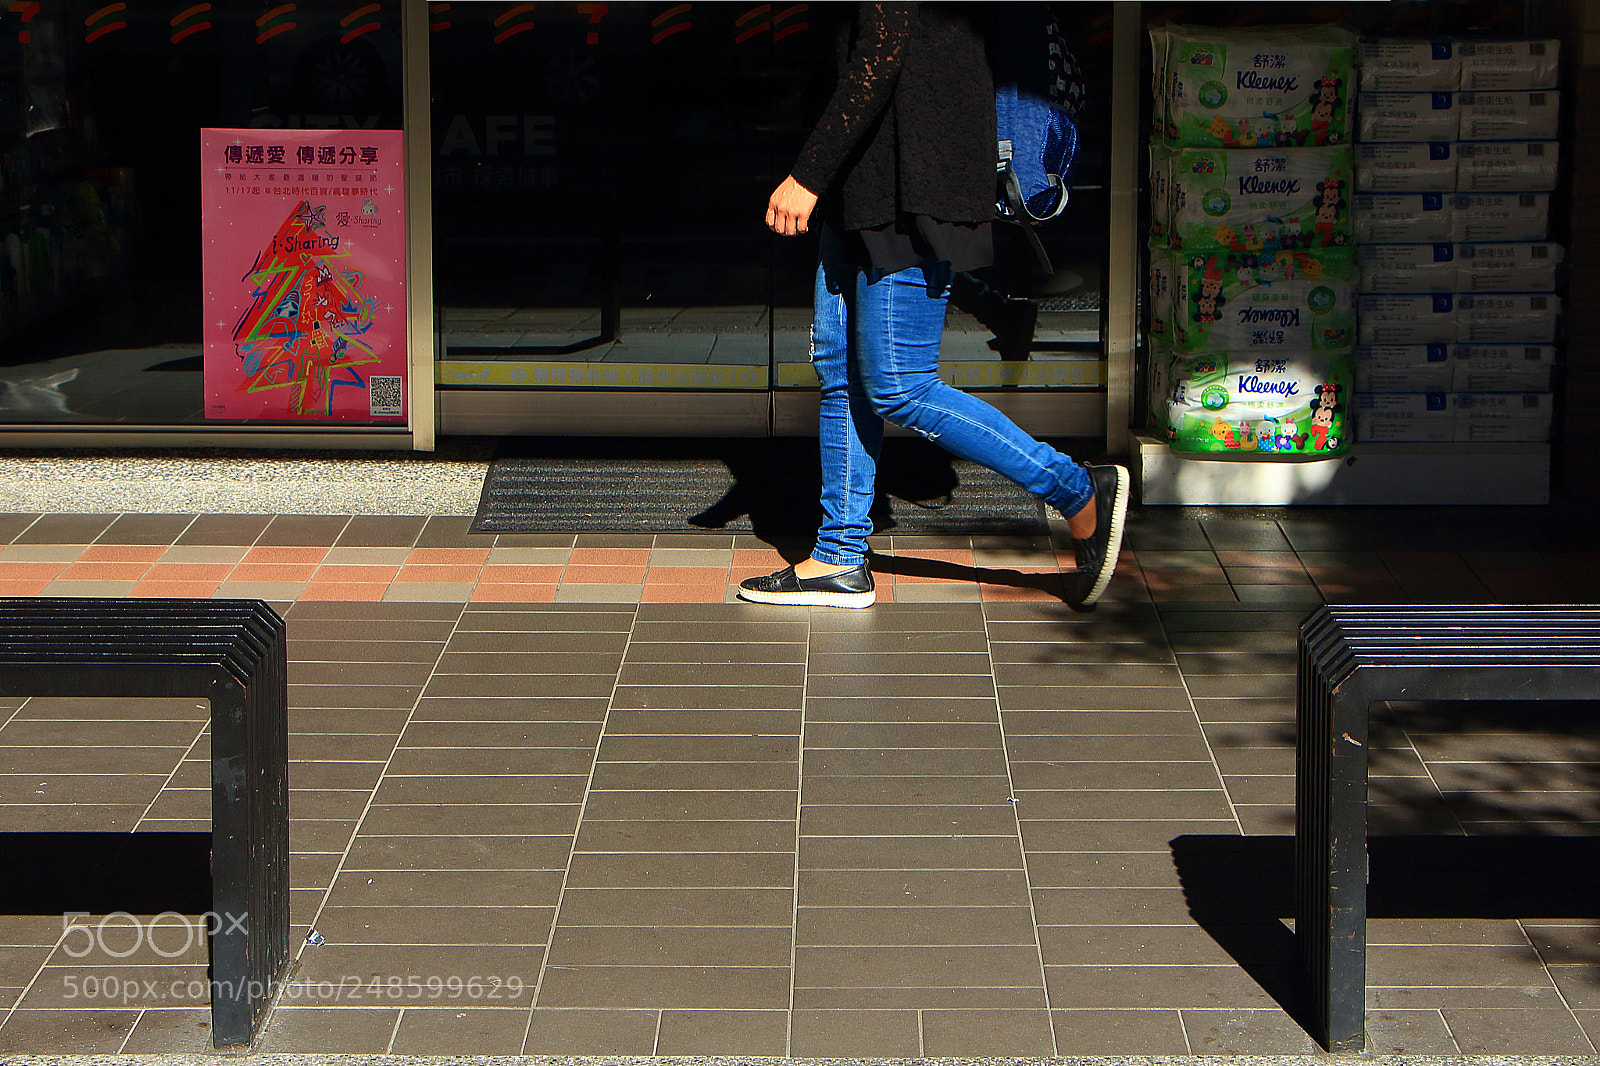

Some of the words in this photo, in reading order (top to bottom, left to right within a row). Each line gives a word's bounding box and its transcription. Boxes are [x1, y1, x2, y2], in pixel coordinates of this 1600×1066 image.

[1253, 53, 1286, 69] 舒潔
[1236, 70, 1299, 94] Kleenex
[439, 114, 557, 156] AFE
[224, 145, 286, 164] 傳遞愛
[296, 145, 379, 165] 傳遞分享
[1254, 158, 1287, 173] 舒潔
[1238, 175, 1301, 197] Kleenex
[1237, 306, 1300, 327] Kleenex
[1252, 330, 1285, 345] 舒潔
[1254, 358, 1288, 374] 舒潔
[1238, 374, 1299, 398] Kleenex
